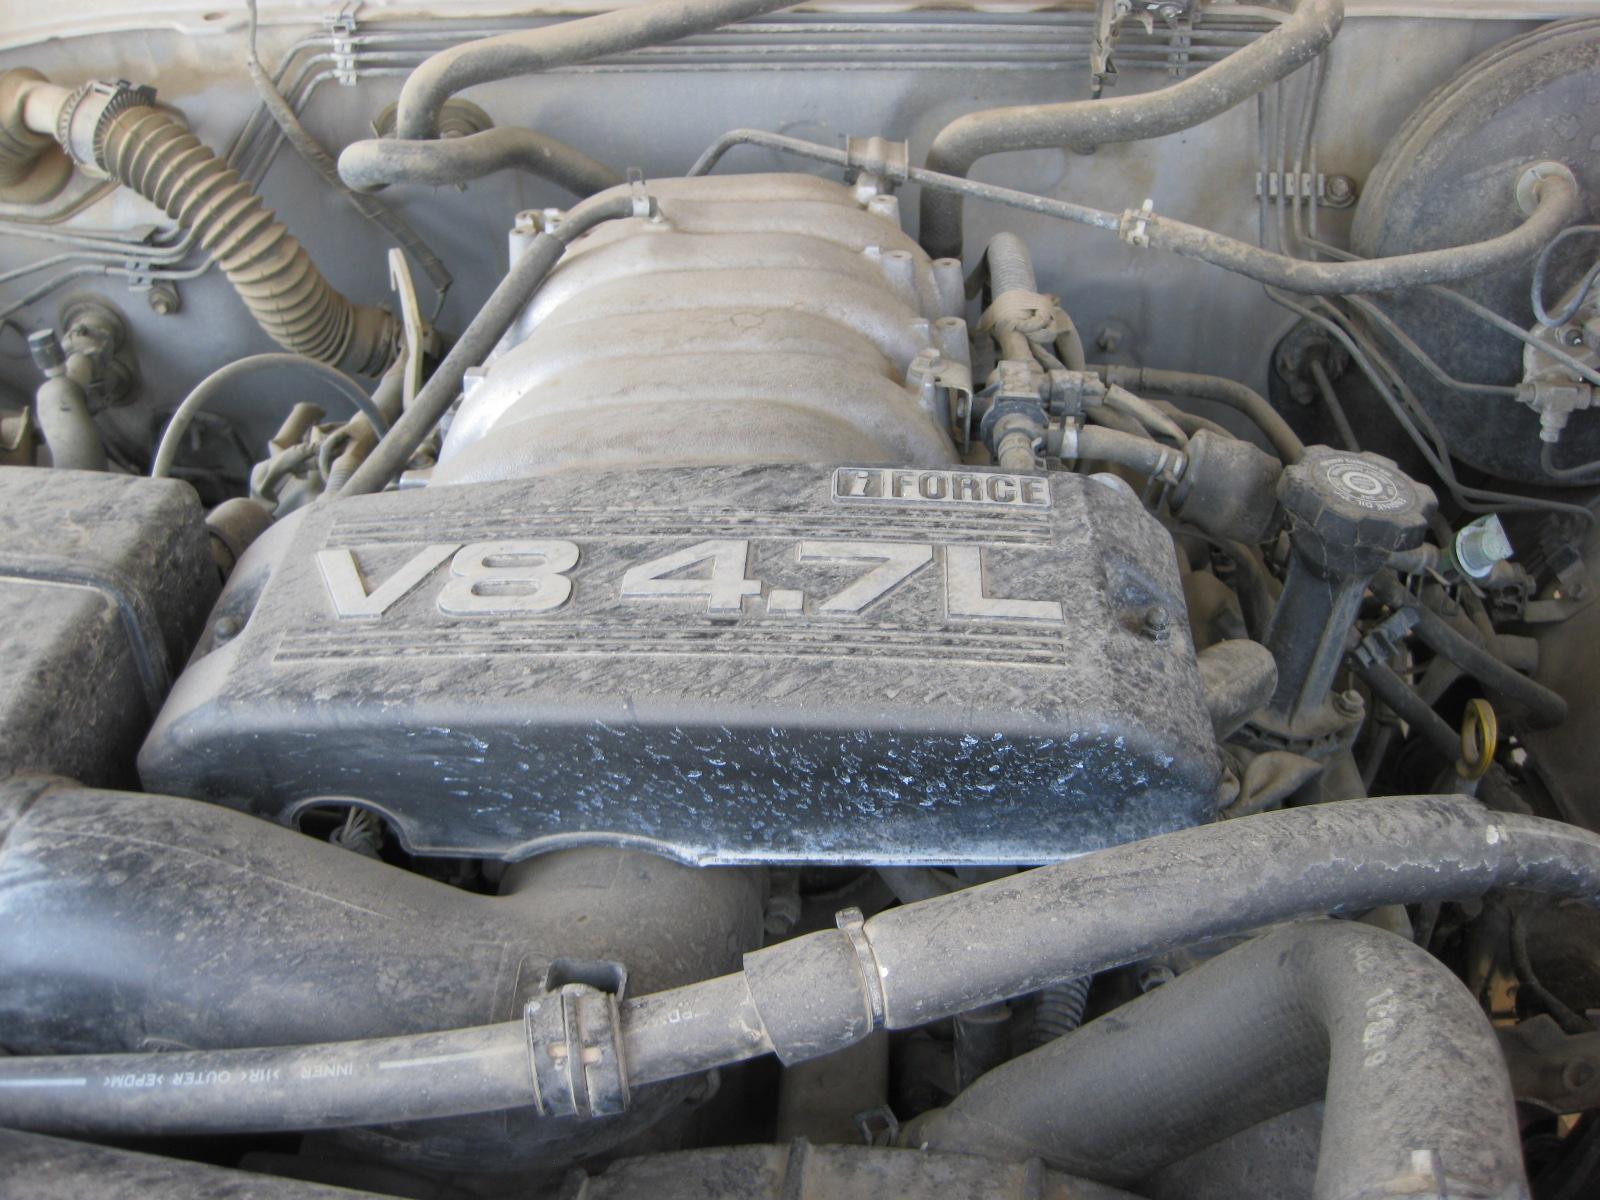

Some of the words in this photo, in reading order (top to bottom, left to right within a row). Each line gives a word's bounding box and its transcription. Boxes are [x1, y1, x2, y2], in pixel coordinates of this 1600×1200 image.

[891, 470, 1050, 505] FORCE
[315, 539, 581, 621] V8
[620, 538, 1065, 626] 4.7L
[172, 1070, 231, 1088] OUTER
[300, 1062, 353, 1080] INNER
